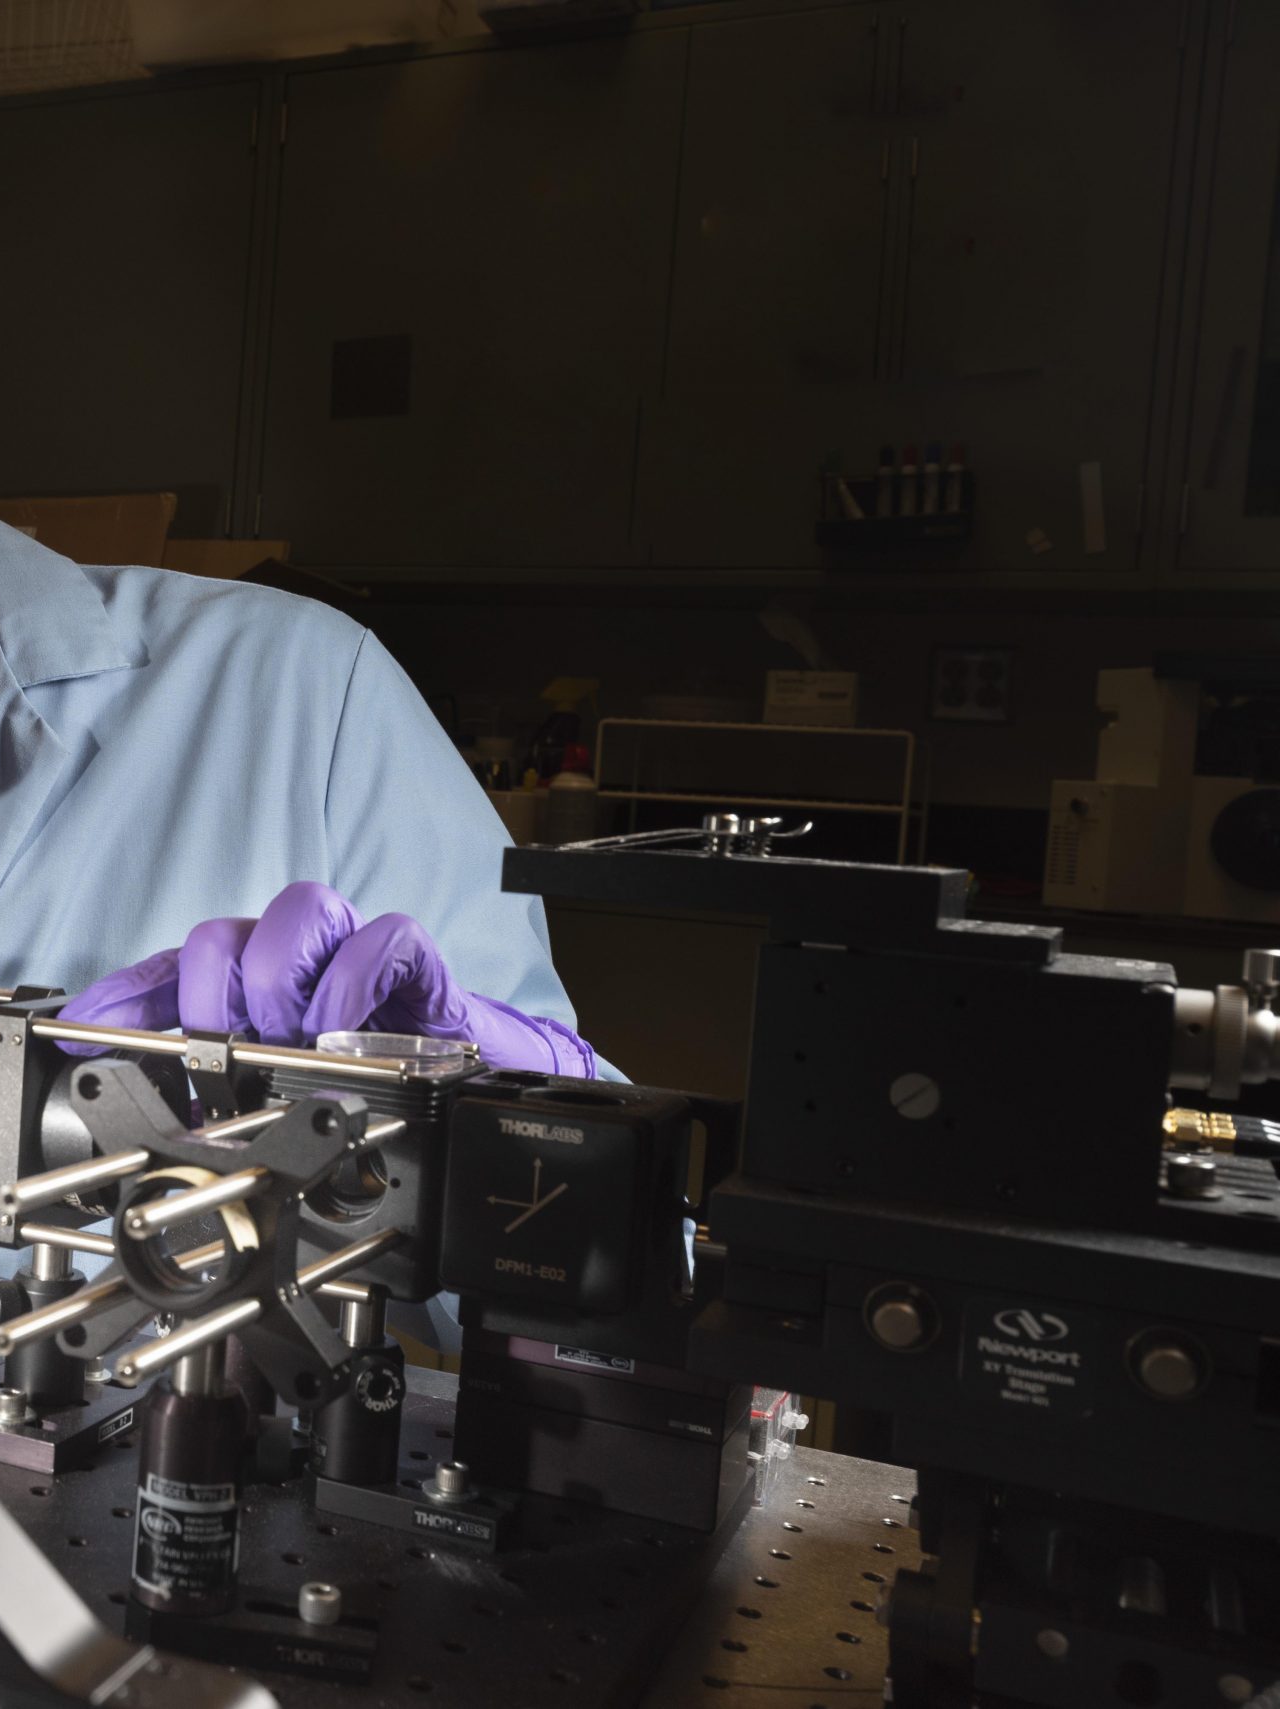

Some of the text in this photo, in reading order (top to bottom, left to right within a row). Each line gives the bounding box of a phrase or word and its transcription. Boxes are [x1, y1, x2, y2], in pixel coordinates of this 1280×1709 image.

[497, 1117, 585, 1145] THORLABS
[495, 1256, 568, 1282] DFM1-E02
[977, 1336, 1081, 1368] Newport
